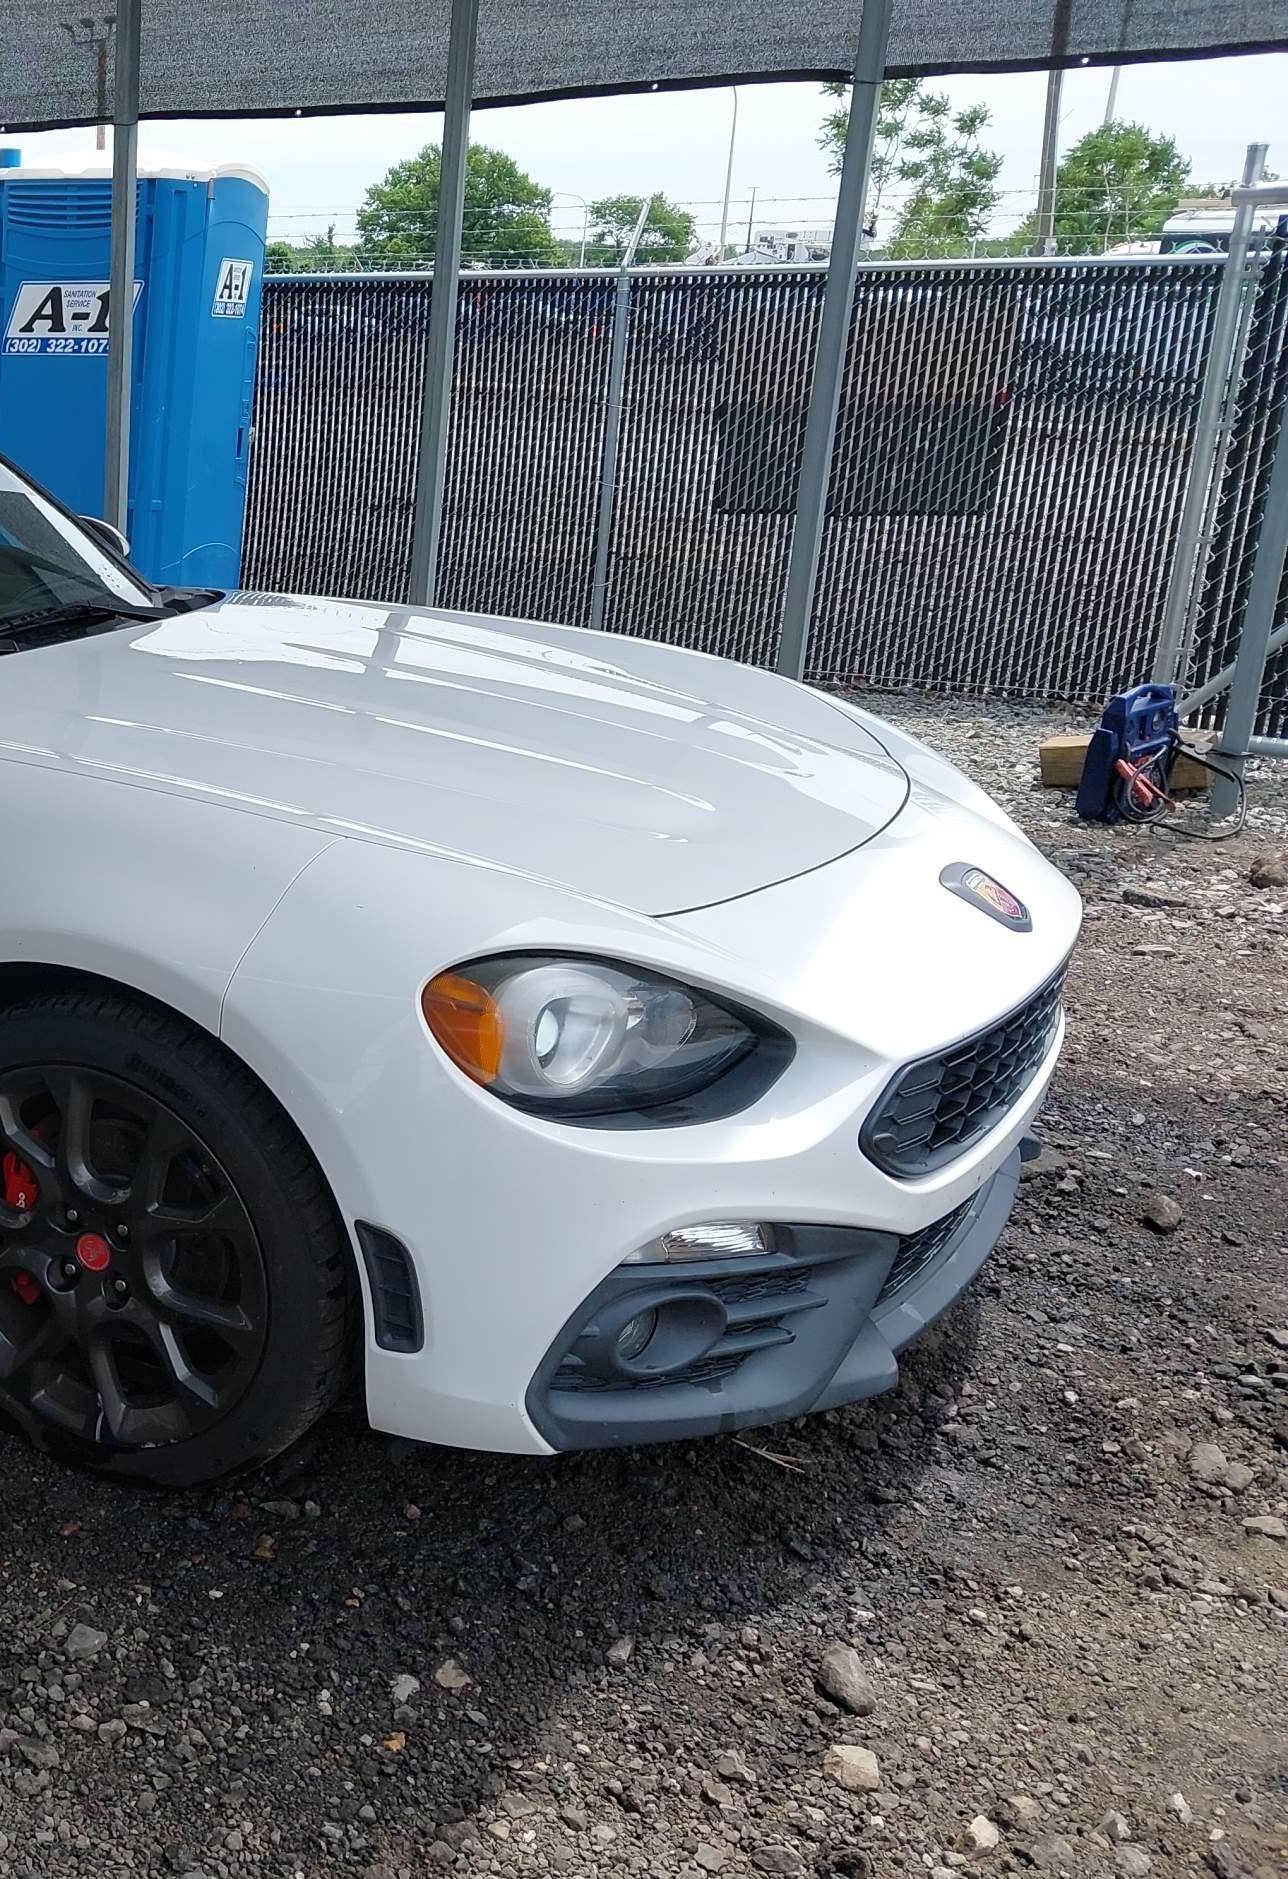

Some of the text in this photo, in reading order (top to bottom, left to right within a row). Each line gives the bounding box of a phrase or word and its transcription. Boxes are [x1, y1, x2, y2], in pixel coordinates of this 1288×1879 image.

[219, 263, 247, 300] A-1
[64, 290, 96, 298] SANITATION
[19, 286, 110, 332] A-1
[66, 300, 91, 308] SERVICE
[5, 339, 110, 353] (302) 322-107
